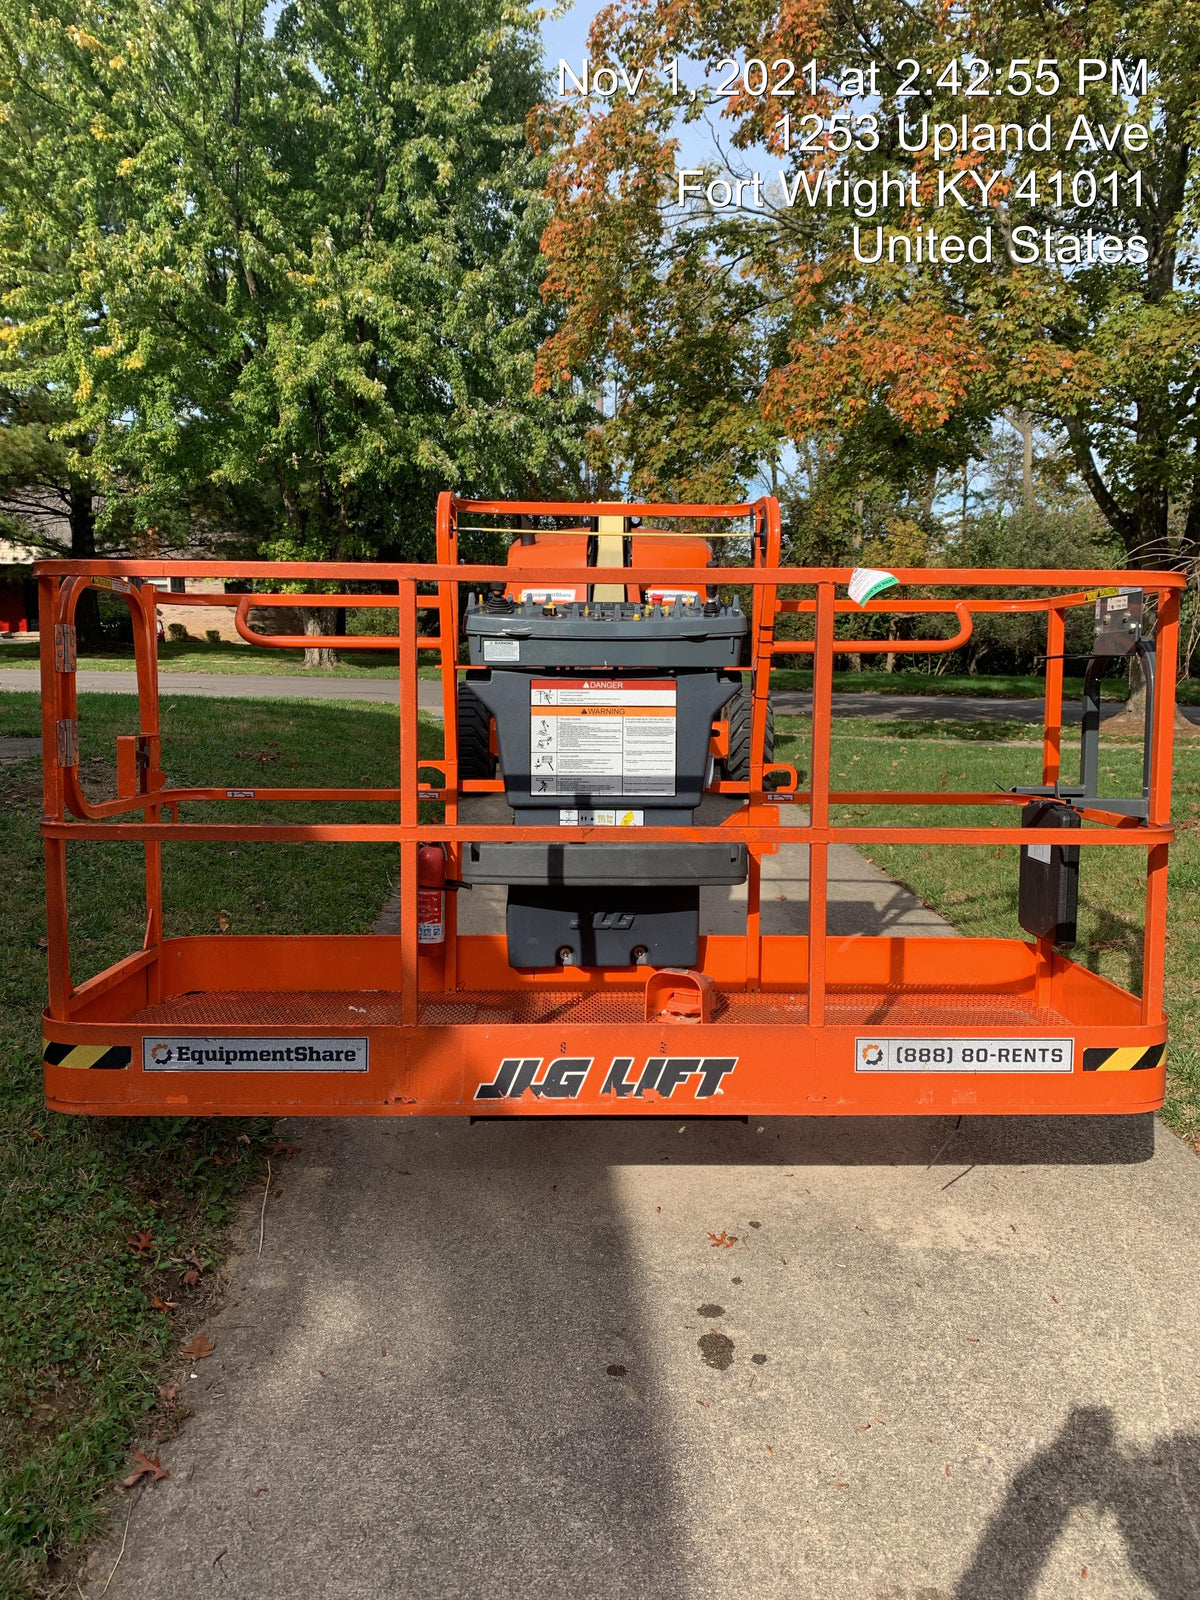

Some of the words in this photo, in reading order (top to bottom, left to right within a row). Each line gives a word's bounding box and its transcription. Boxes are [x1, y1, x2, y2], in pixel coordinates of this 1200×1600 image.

[590, 681, 624, 689] DANGER
[588, 707, 626, 715] WARNING
[176, 1045, 357, 1066] EquipmentShare
[896, 1047, 953, 1064] (888)
[961, 1047, 1064, 1064] 80-RENTS
[473, 1057, 595, 1100] JLG
[600, 1057, 739, 1100] LIFT
